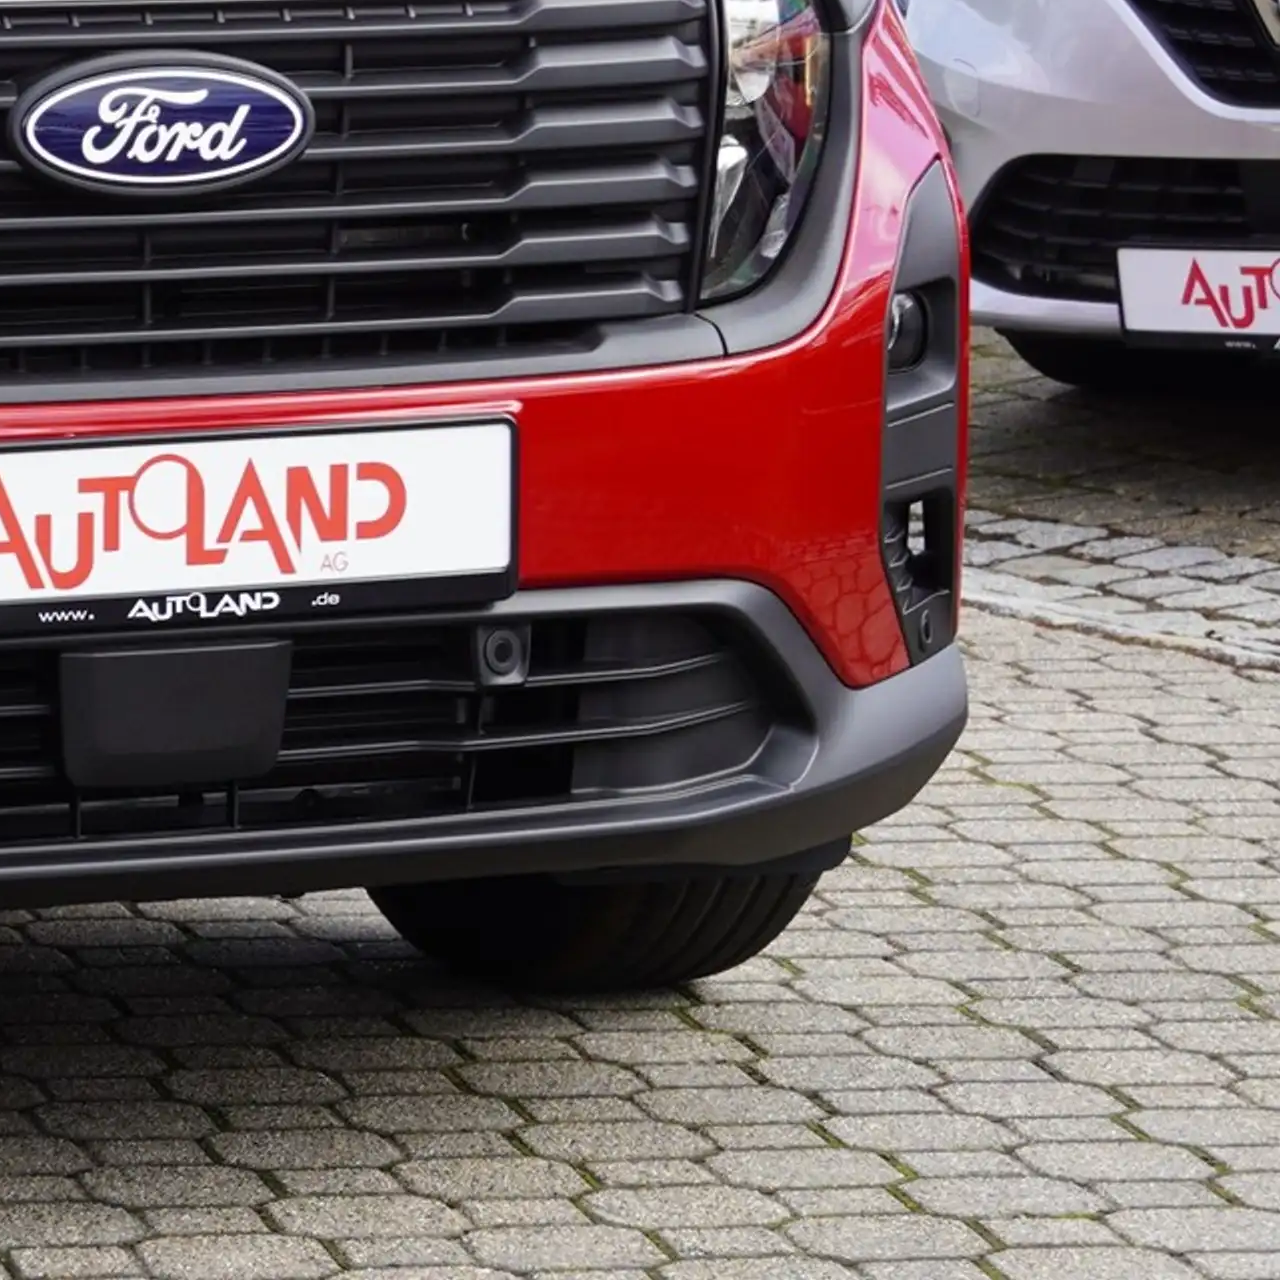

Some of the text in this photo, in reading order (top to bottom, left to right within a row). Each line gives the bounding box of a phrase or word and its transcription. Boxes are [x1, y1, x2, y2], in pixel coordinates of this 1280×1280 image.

[81, 86, 251, 164] Ford
[1181, 257, 1280, 329] AUT
[320, 551, 349, 572] AG
[38, 591, 340, 621] www. AUTOLAND .de
